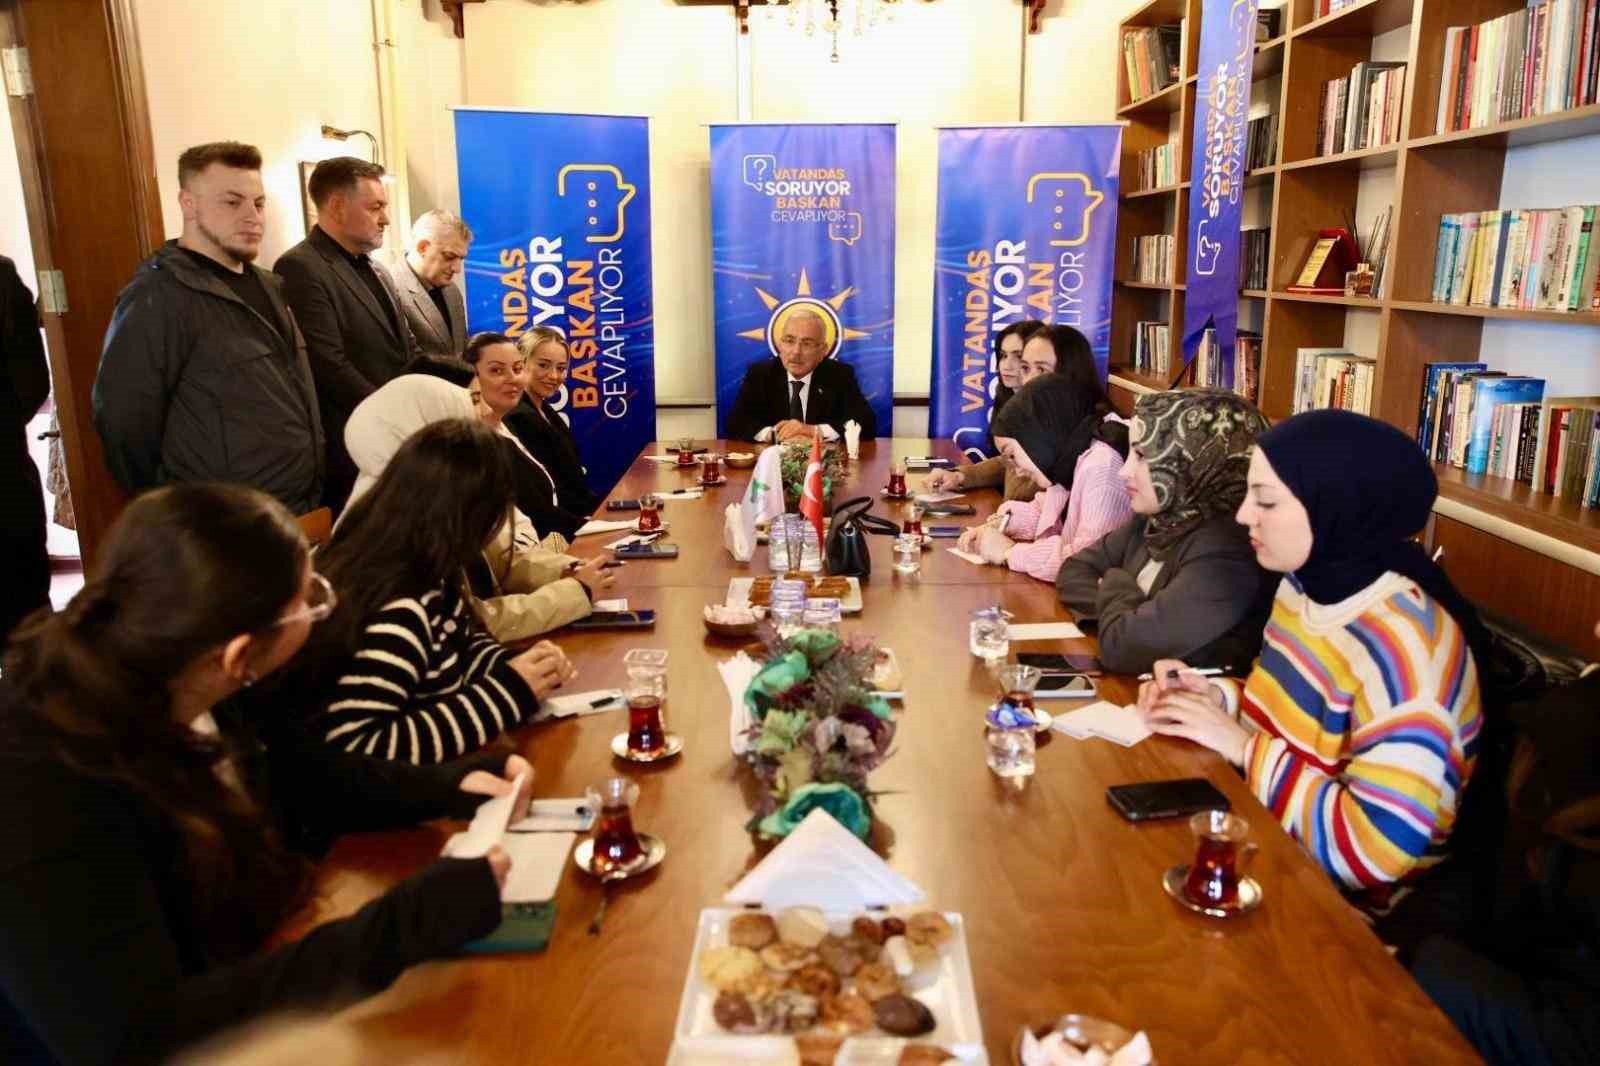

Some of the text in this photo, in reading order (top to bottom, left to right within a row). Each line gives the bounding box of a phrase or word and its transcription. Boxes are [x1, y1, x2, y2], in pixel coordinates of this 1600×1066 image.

[765, 180, 851, 196] SORUYOR
[1209, 62, 1228, 218] SORUYOR
[598, 248, 627, 418] CEVAPLIYOR
[1056, 251, 1085, 326] LIYOR
